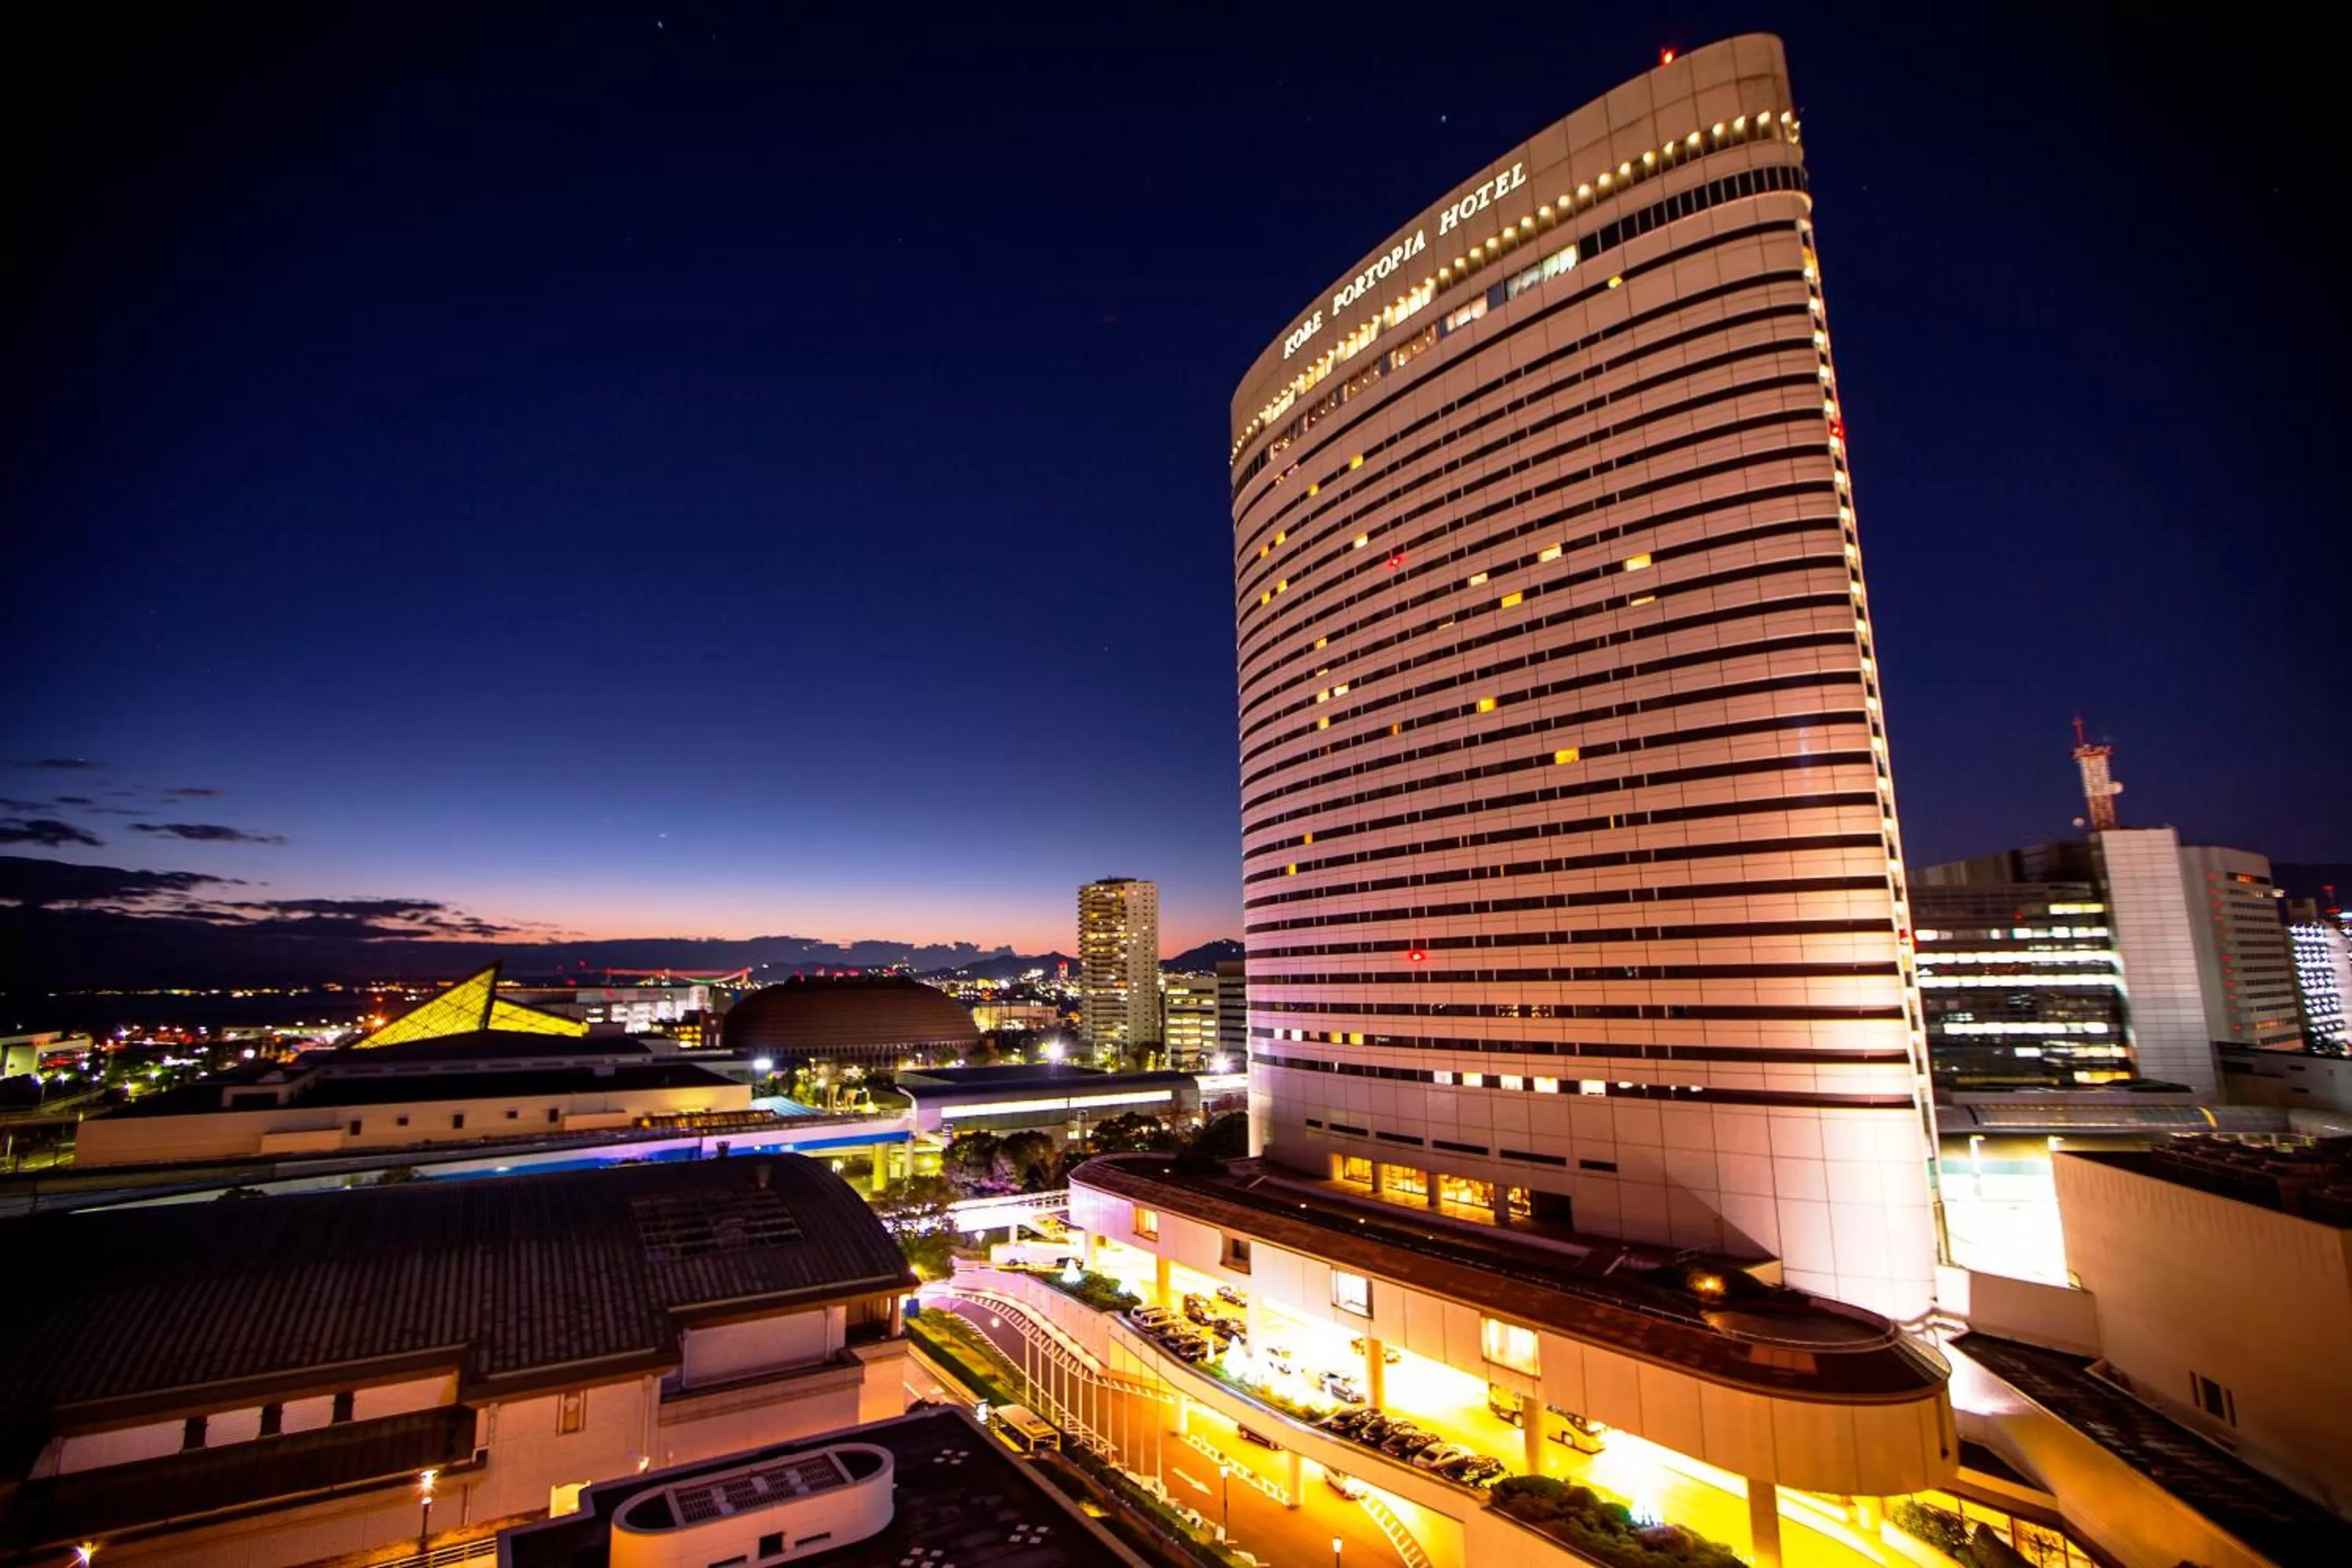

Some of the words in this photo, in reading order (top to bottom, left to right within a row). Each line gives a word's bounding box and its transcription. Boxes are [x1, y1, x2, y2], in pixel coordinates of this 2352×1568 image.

[1283, 310, 1322, 359] KOBE
[1333, 230, 1425, 315] PORTOPIA
[1439, 162, 1526, 235] HOTEL
